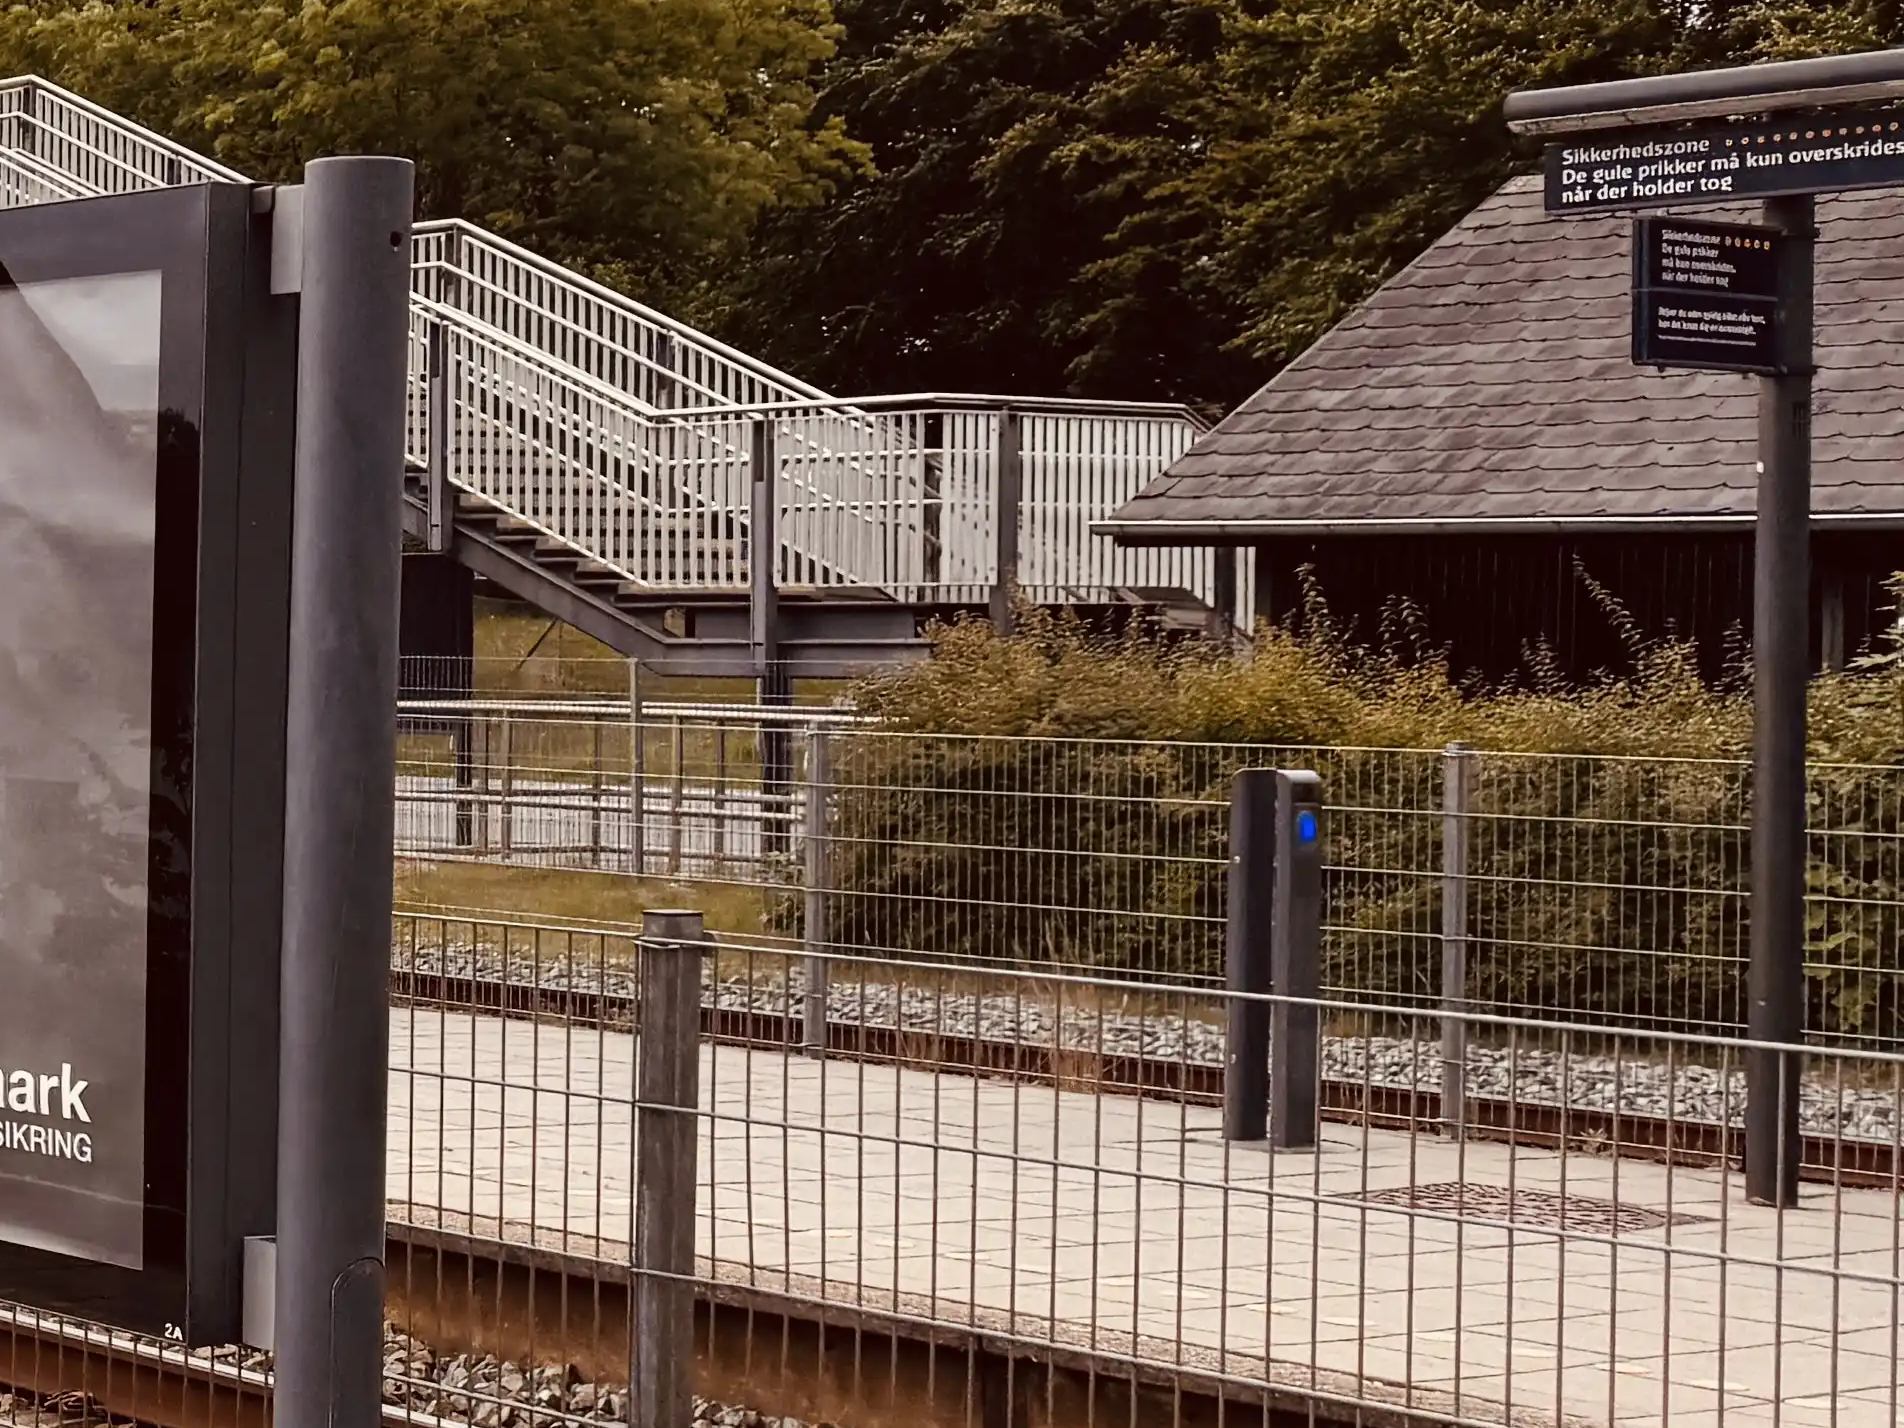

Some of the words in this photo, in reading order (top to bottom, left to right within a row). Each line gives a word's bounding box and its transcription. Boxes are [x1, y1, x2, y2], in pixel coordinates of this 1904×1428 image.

[1562, 138, 1710, 166] Sikkerhedszone
[1562, 169, 1587, 185] De
[1593, 164, 1632, 184] gule
[1638, 156, 1705, 181] prikker
[1711, 153, 1740, 171] må
[1746, 149, 1783, 167] kun
[1562, 185, 1592, 204] når
[1597, 183, 1628, 201] der
[1633, 175, 1694, 197] holder
[1700, 174, 1733, 192] tog
[164, 1322, 184, 1341] 2A
